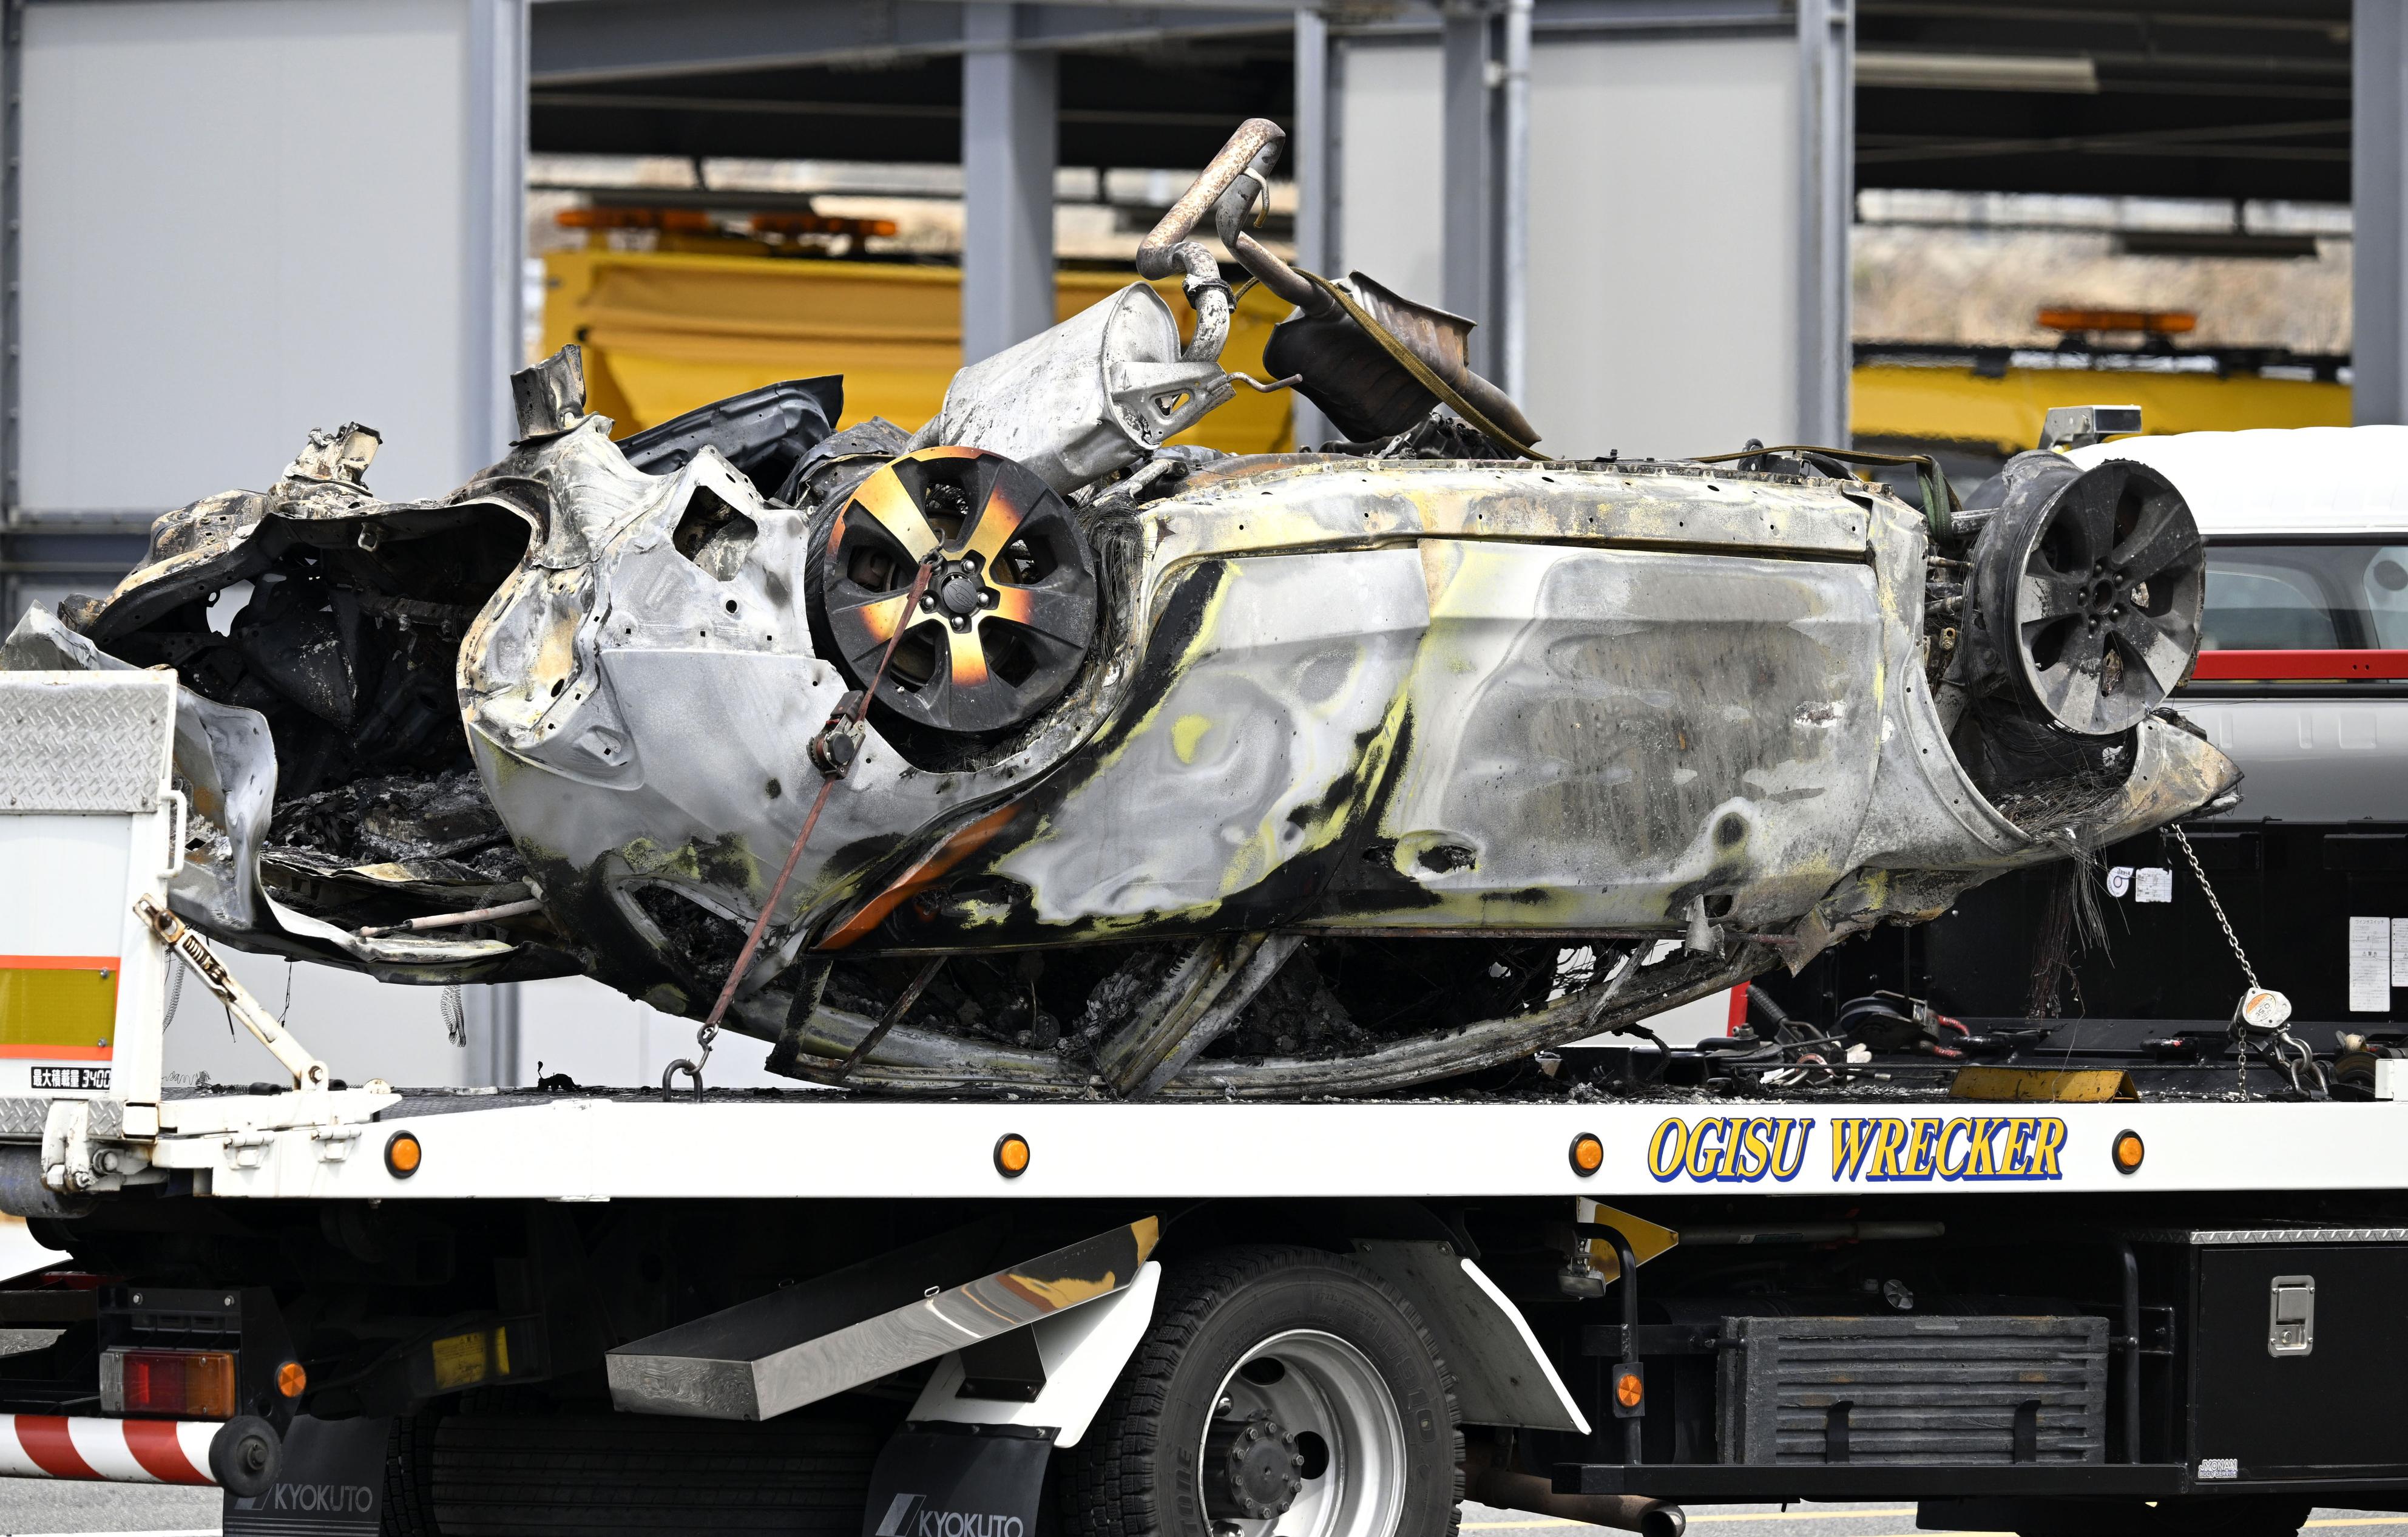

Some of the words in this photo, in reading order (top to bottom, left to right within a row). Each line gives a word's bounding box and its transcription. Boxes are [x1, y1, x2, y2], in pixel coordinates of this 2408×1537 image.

[33, 1069, 79, 1087] 最大積載量
[82, 1070, 111, 1088] 3400
[1648, 1117, 1815, 1182] OGISU
[1830, 1117, 2068, 1182] WRECKER
[1373, 1321, 1437, 1442] W910
[2199, 1460, 2237, 1471] JYONAN
[275, 1483, 373, 1512] KYOKUTO
[919, 1510, 1024, 1537] KYOKUTO
